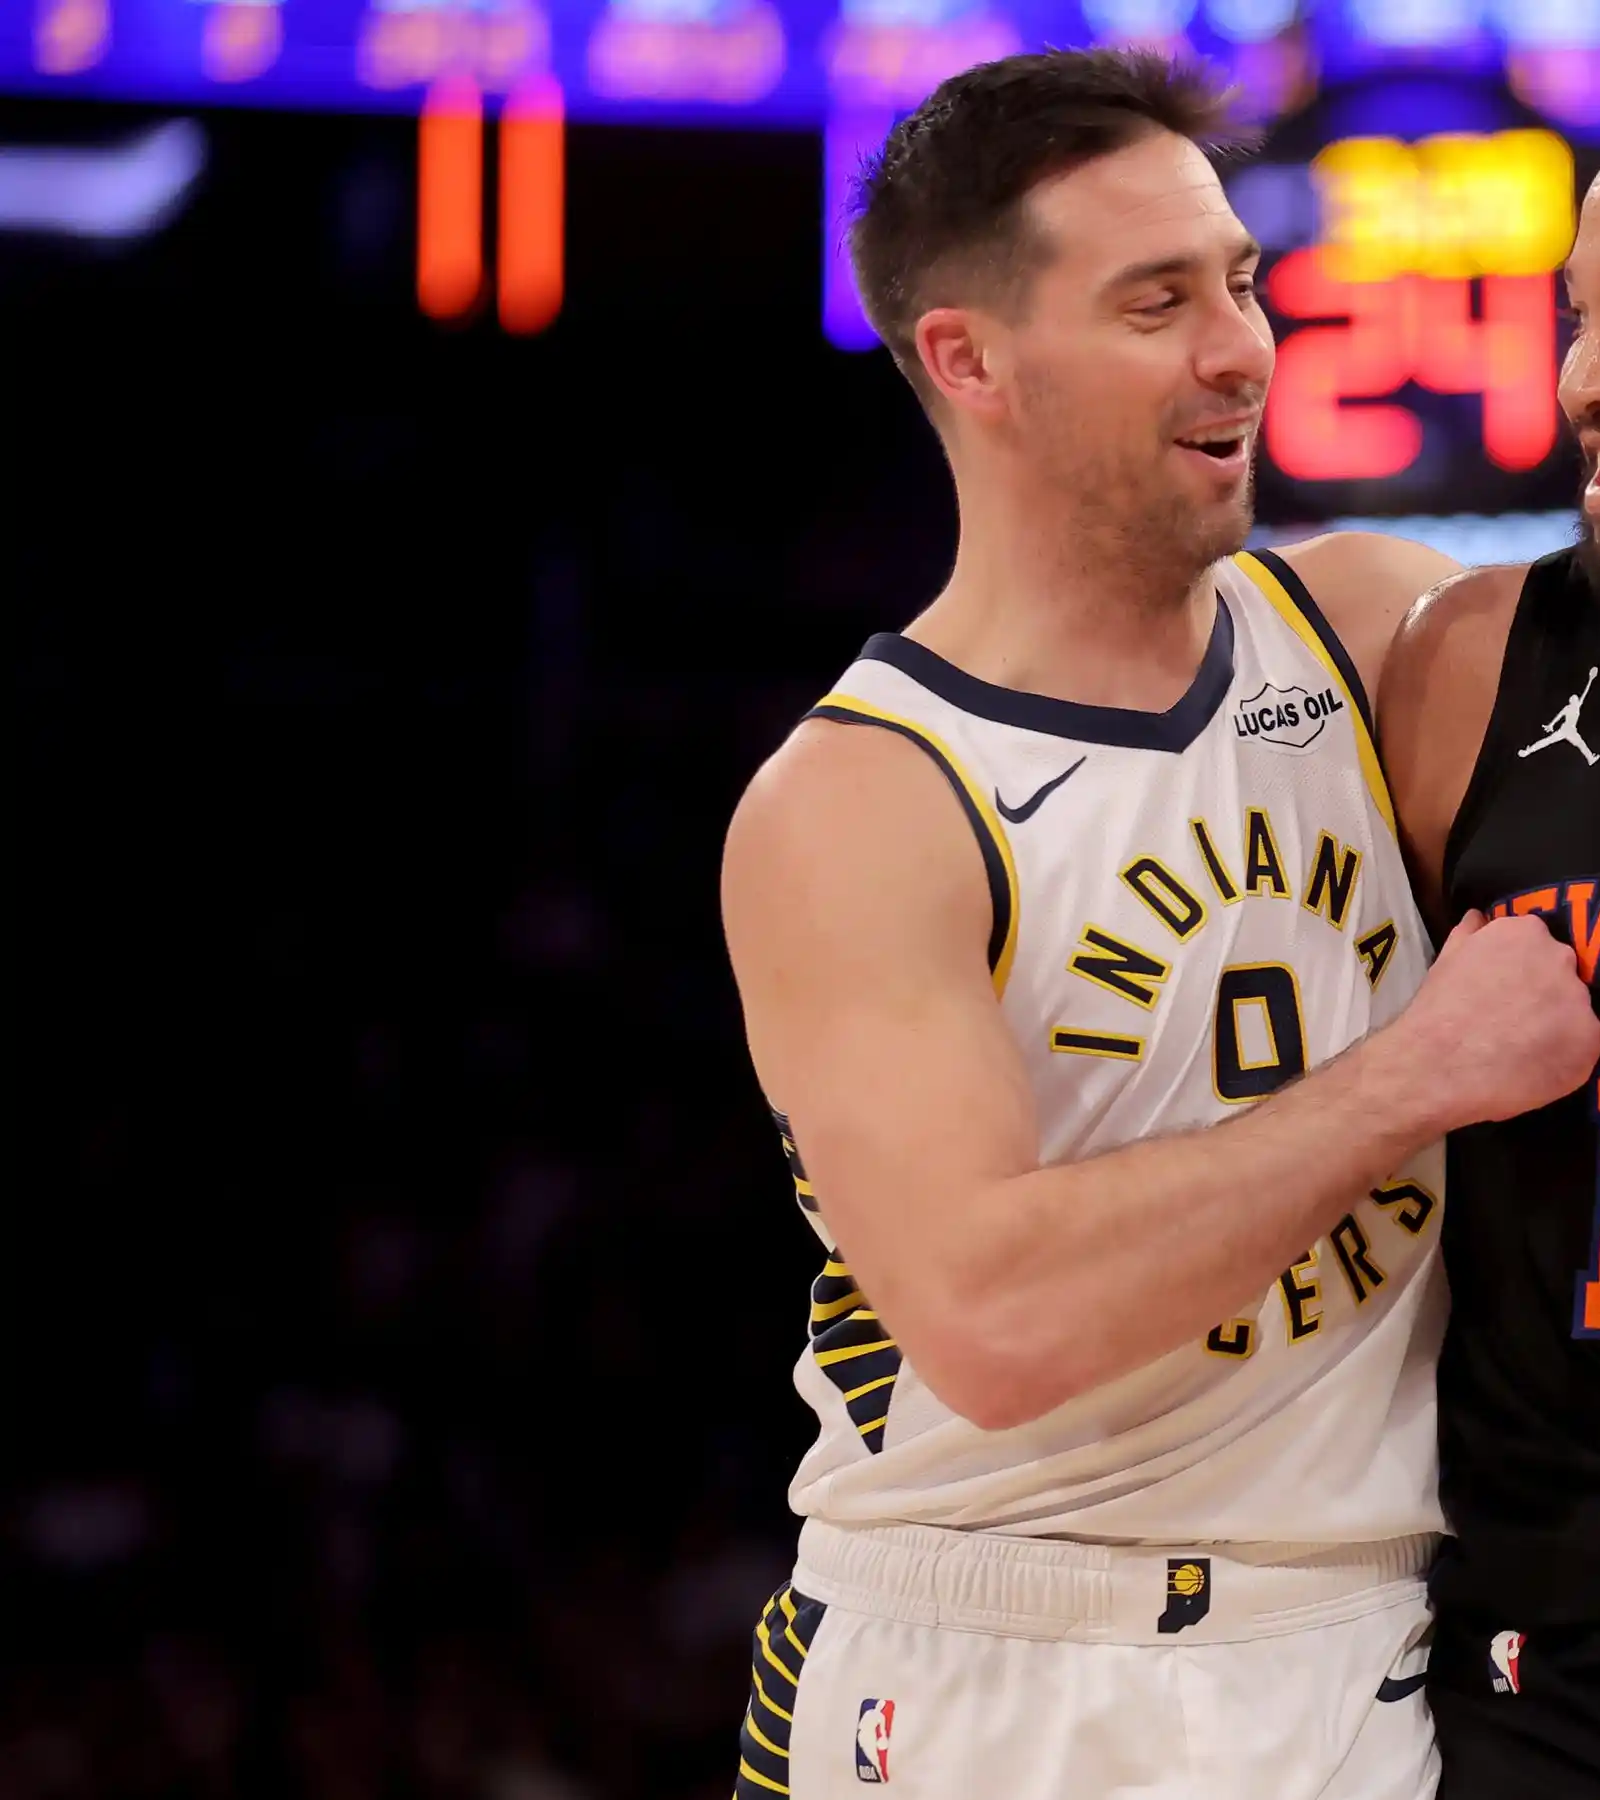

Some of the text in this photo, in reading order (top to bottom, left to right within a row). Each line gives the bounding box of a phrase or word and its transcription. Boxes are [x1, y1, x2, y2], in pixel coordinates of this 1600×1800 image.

[1267, 246, 1558, 481] 24
[1233, 688, 1344, 737] LUCAS OIL
[1049, 804, 1400, 1065] INDIANA
